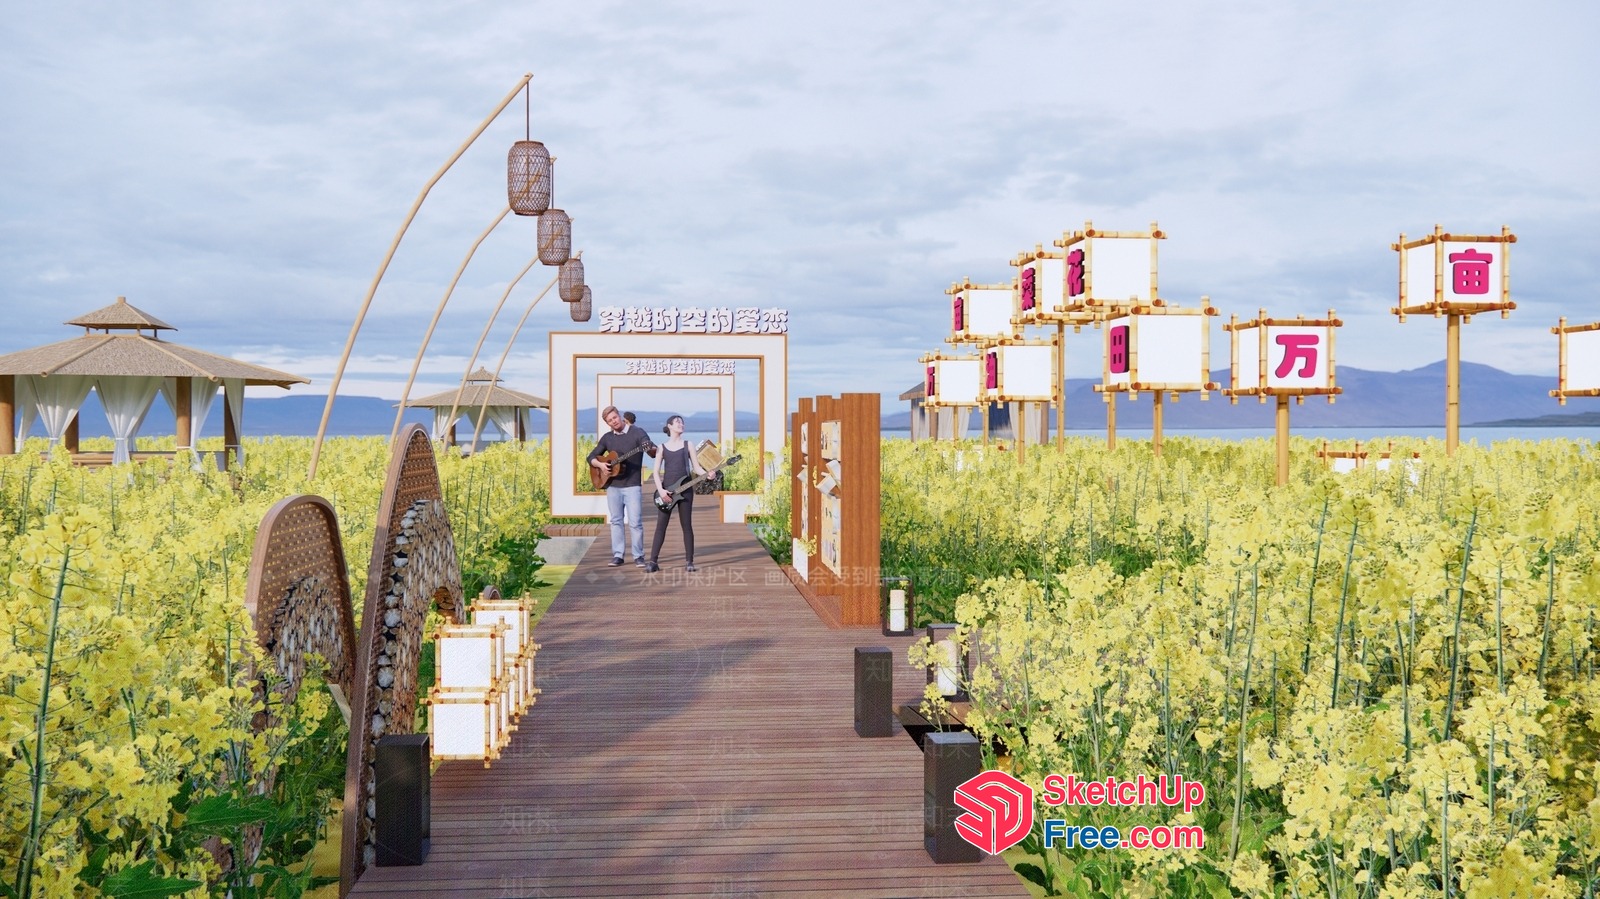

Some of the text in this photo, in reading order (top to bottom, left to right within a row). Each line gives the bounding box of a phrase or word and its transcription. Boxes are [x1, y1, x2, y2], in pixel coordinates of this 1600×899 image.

[1066, 248, 1085, 297] 花
[1449, 248, 1493, 294] 亩
[598, 305, 789, 334] 穿越时空的爱恋
[625, 358, 736, 375] 穿越时空的爱恋
[1110, 325, 1130, 374] 田
[1275, 334, 1320, 378] 万
